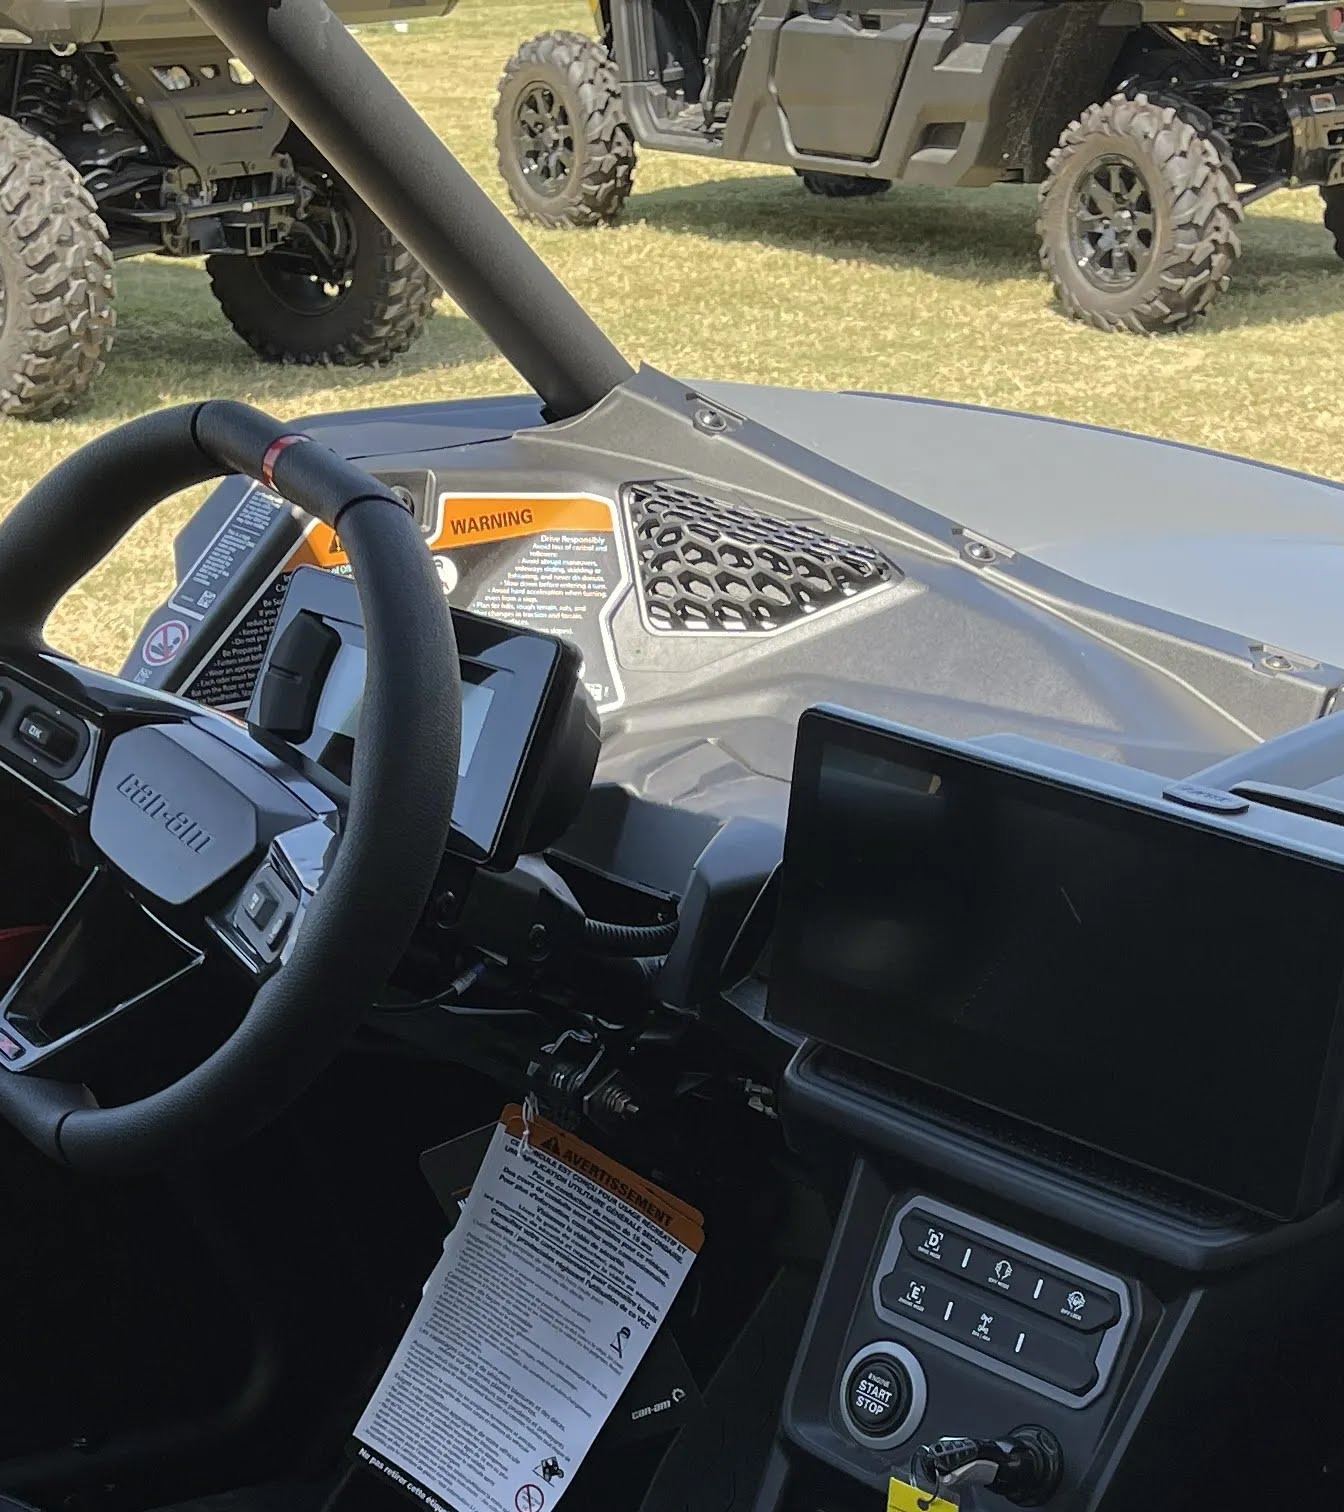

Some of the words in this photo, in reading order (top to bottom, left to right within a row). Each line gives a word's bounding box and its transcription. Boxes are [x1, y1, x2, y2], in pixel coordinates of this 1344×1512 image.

[450, 509, 533, 535] WARNING
[562, 536, 605, 545] Responsibly
[560, 1146, 674, 1229] AVERTISSEMENT
[859, 1379, 893, 1403] START
[631, 1399, 672, 1421] can-am
[855, 1395, 884, 1415] STOP
